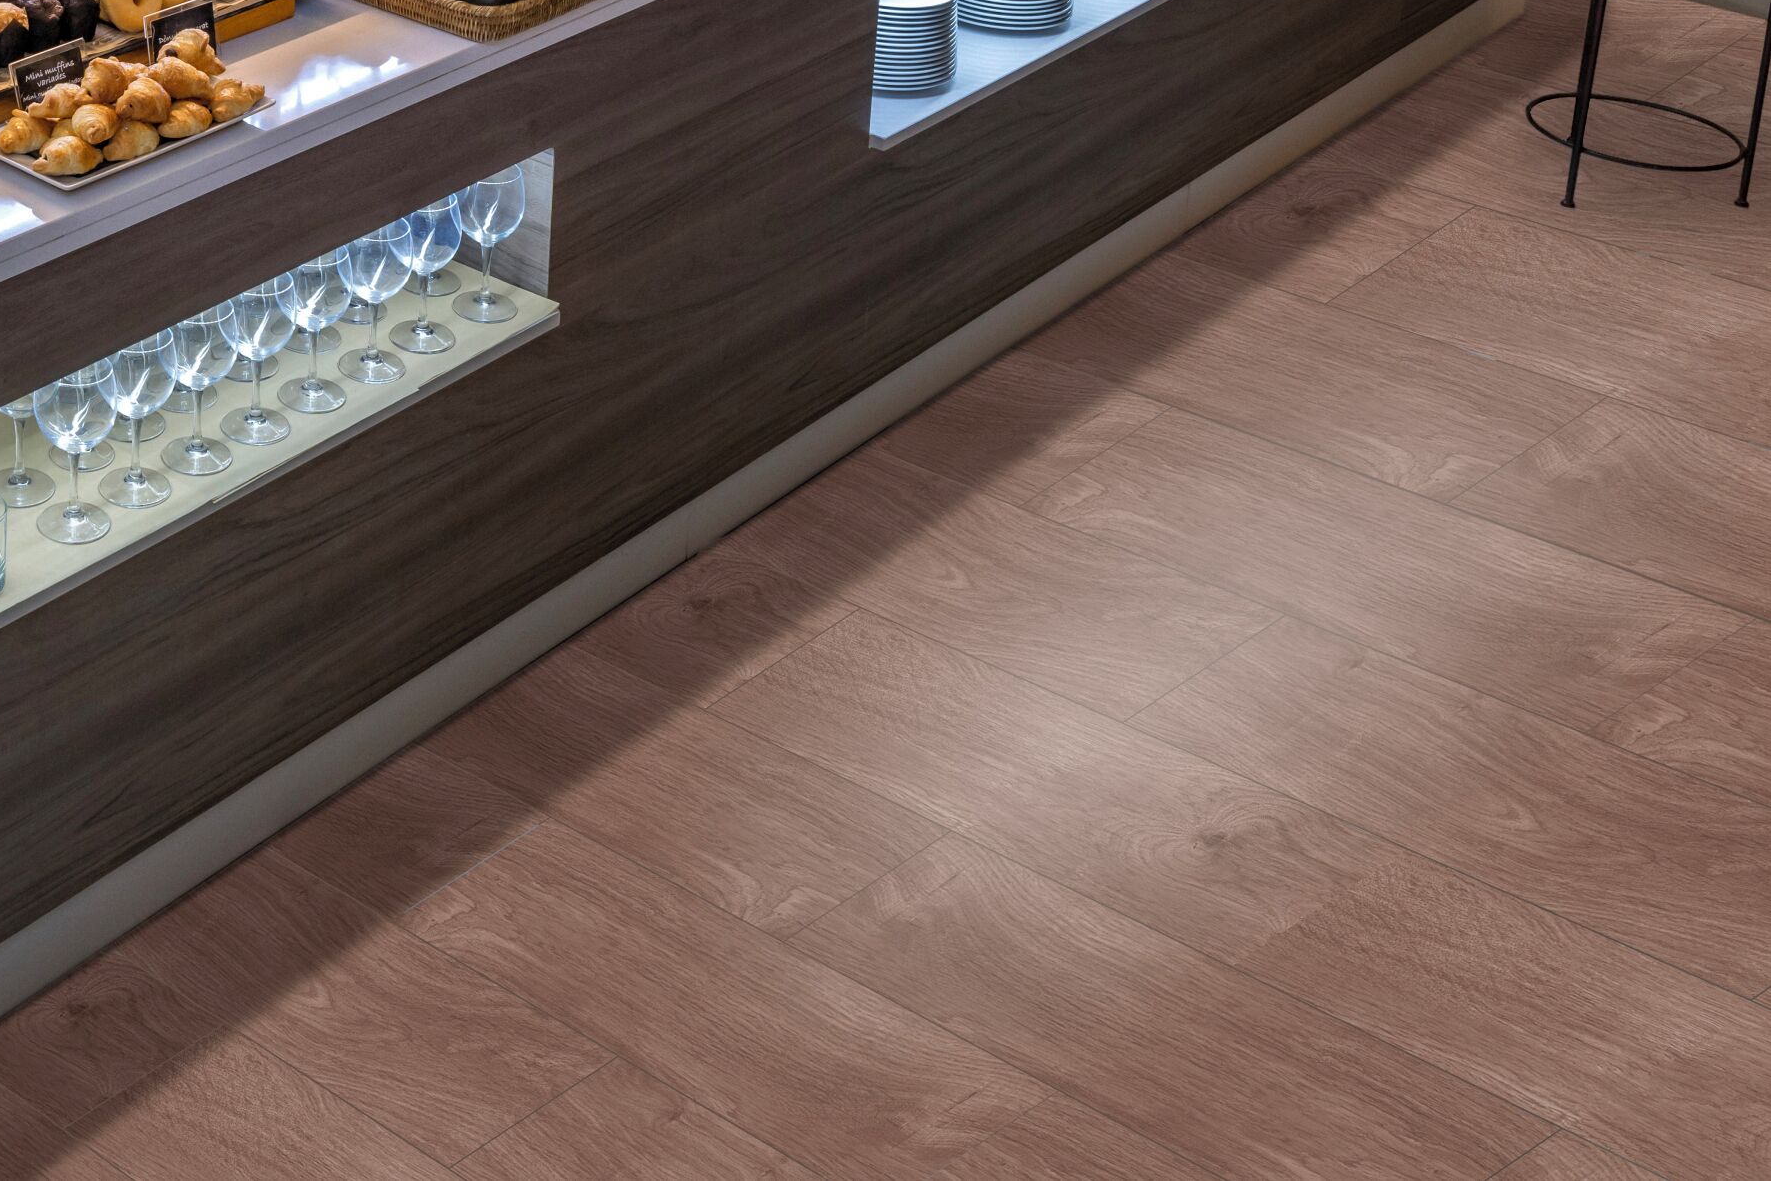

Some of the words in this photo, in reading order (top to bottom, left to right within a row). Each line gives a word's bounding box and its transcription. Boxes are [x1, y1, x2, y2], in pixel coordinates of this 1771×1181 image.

[25, 69, 44, 83] Mini
[44, 59, 75, 75] muffins
[36, 72, 67, 88] variades
[22, 92, 37, 103] Mini
